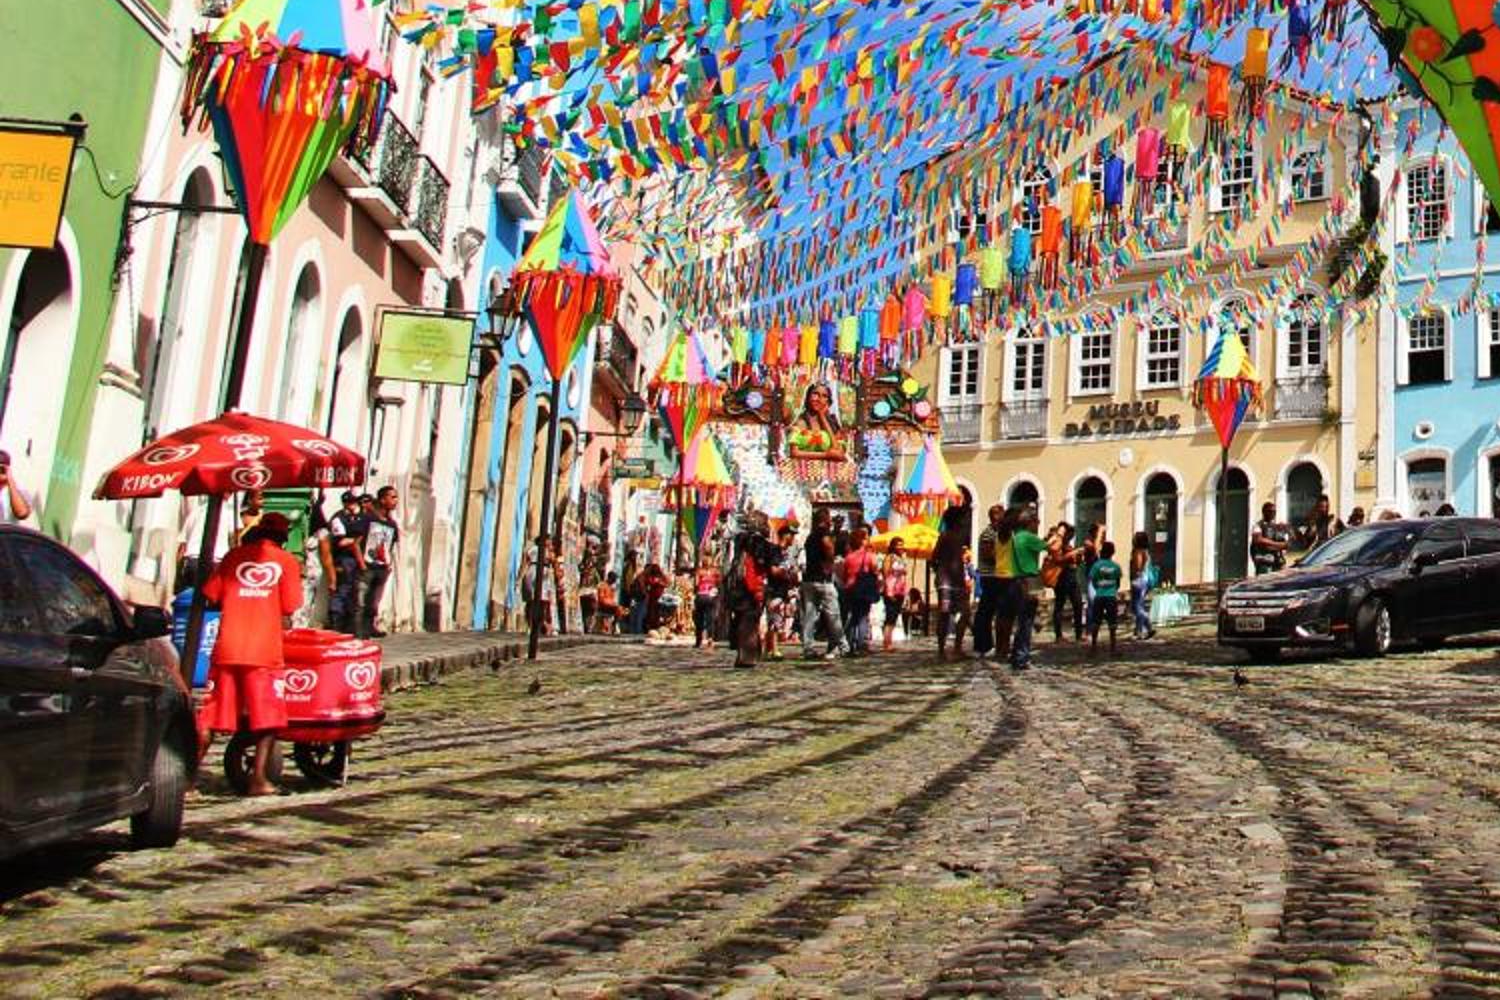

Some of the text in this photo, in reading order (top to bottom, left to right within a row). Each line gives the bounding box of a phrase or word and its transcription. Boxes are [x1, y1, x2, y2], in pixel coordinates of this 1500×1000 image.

[1089, 399, 1159, 420] MUSEU
[1065, 414, 1180, 438] DA CIDADE
[121, 472, 178, 491] KIBON
[315, 466, 356, 482] KIBON
